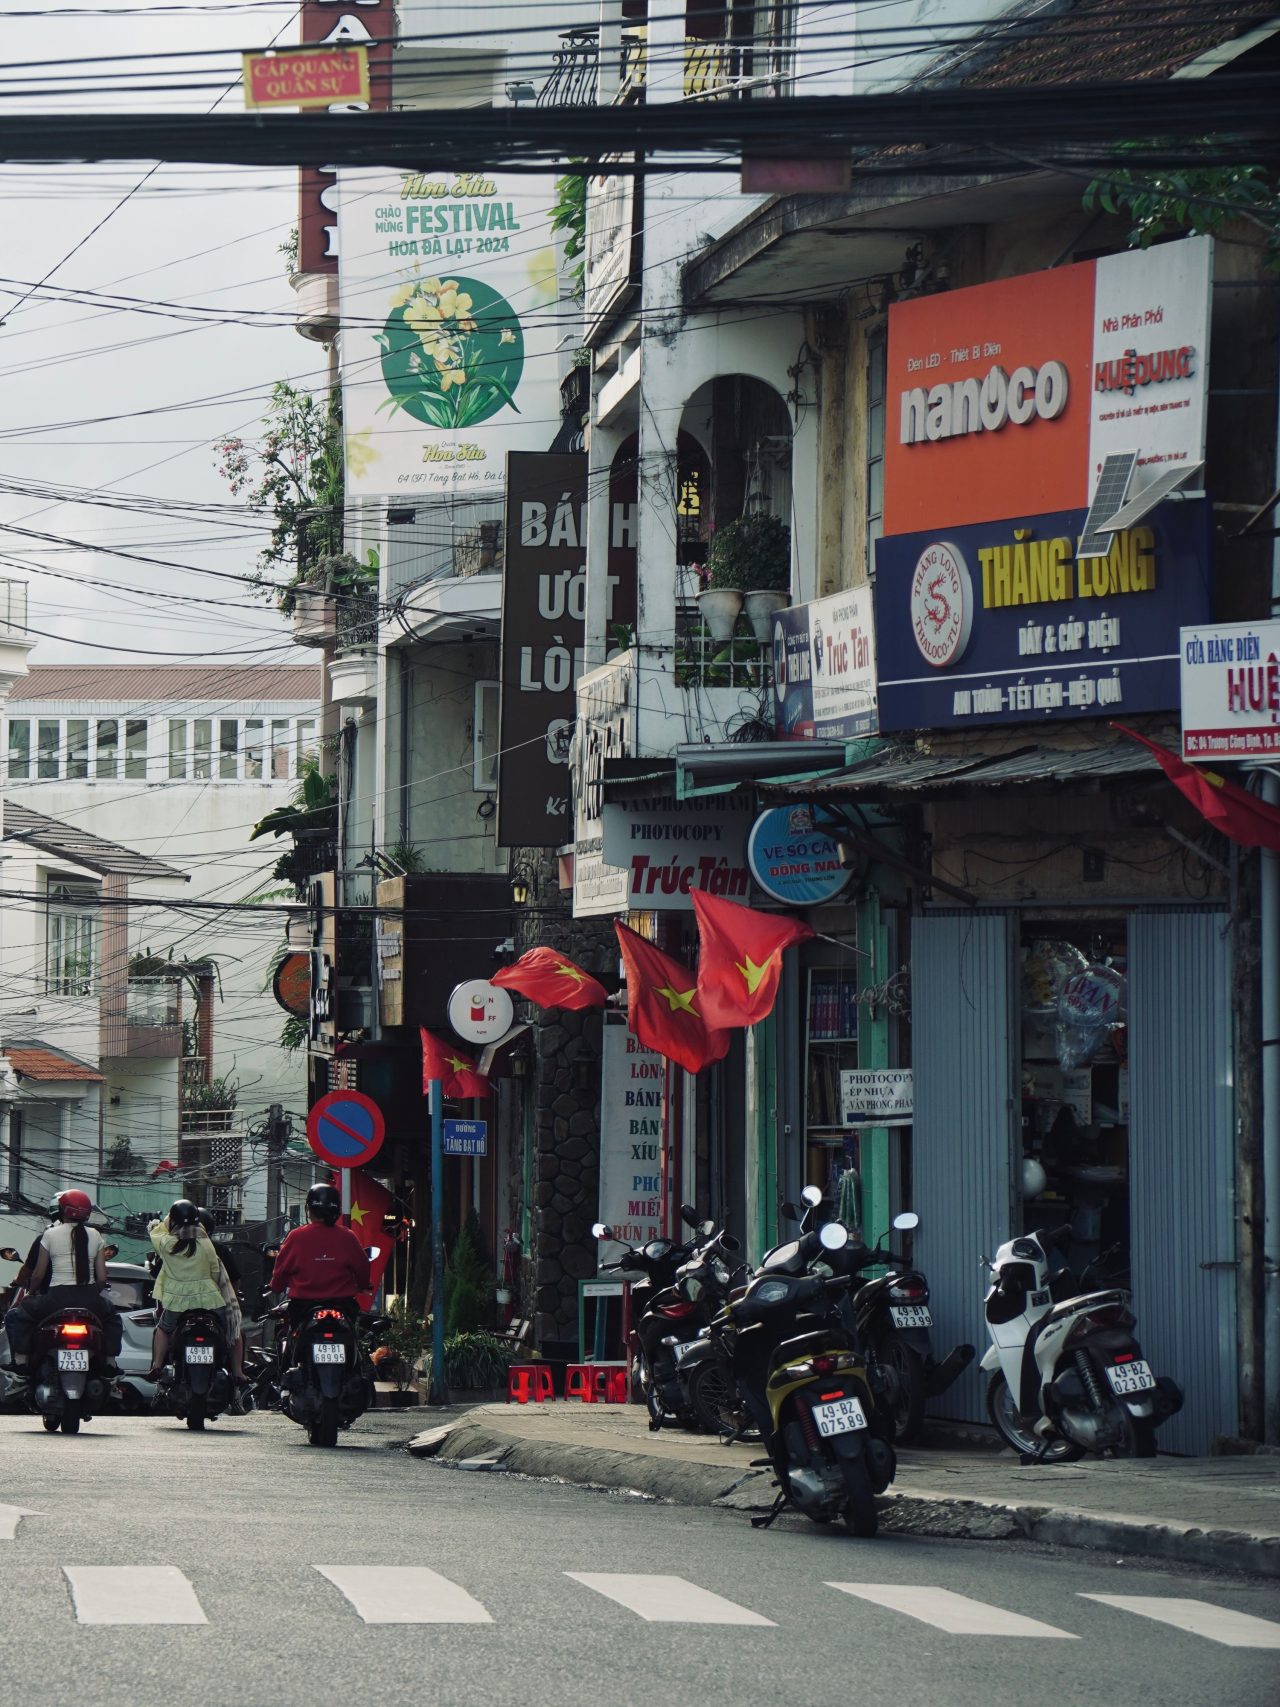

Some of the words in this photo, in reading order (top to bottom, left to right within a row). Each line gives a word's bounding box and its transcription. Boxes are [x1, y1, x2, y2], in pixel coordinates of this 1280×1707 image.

[254, 58, 288, 78] CÁP
[292, 55, 355, 76] QUANG
[266, 77, 316, 96] QUÂN
[320, 75, 344, 94] SỰ
[400, 173, 449, 200] Hoa
[375, 204, 401, 218] CHÀO
[406, 202, 520, 234] FESTIVAL
[375, 218, 403, 233] MỪNG
[389, 240, 417, 256] HOA
[421, 235, 442, 255] ĐÀ
[446, 238, 472, 259] LẠT
[476, 237, 510, 253] 2024
[1103, 317, 1118, 334] Nhà
[1121, 311, 1142, 330] Phân
[1144, 305, 1164, 325] Phối
[926, 353, 941, 369] LED
[900, 360, 1070, 445] nanoco
[521, 492, 638, 548] BÁH
[940, 553, 959, 594] LONG
[978, 529, 1071, 608] THĂNG
[1077, 527, 1155, 598] LONG
[1019, 619, 1042, 655] DÂY
[1045, 625, 1057, 653] &
[1058, 615, 1085, 651] CÁP
[1088, 611, 1120, 654] ĐIỆN
[826, 632, 848, 676] Trúc
[850, 626, 869, 670] Tân
[1186, 634, 1205, 664] CỬA
[1207, 634, 1233, 663] HÀNG
[1236, 631, 1260, 665] ĐIỆN
[631, 823, 723, 840] PHOTOCOPY
[631, 855, 694, 894] Trúc
[697, 855, 750, 896] Tân
[631, 1059, 659, 1079] LÒN
[849, 1073, 913, 1084] PHOTOCOPY
[629, 1116, 659, 1135] BÁN
[631, 1141, 657, 1160] XÍU
[612, 1222, 642, 1241] BÚN
[898, 1306, 925, 1316] 49-B1
[62, 1352, 84, 1360] 79-C1
[318, 1345, 340, 1353] 49-B1
[60, 1361, 87, 1370] 725.33
[1115, 1363, 1145, 1379] 49-B2
[1115, 1374, 1153, 1394] 023.07
[822, 1401, 855, 1419] 49-B2
[821, 1413, 864, 1434] 075.89
